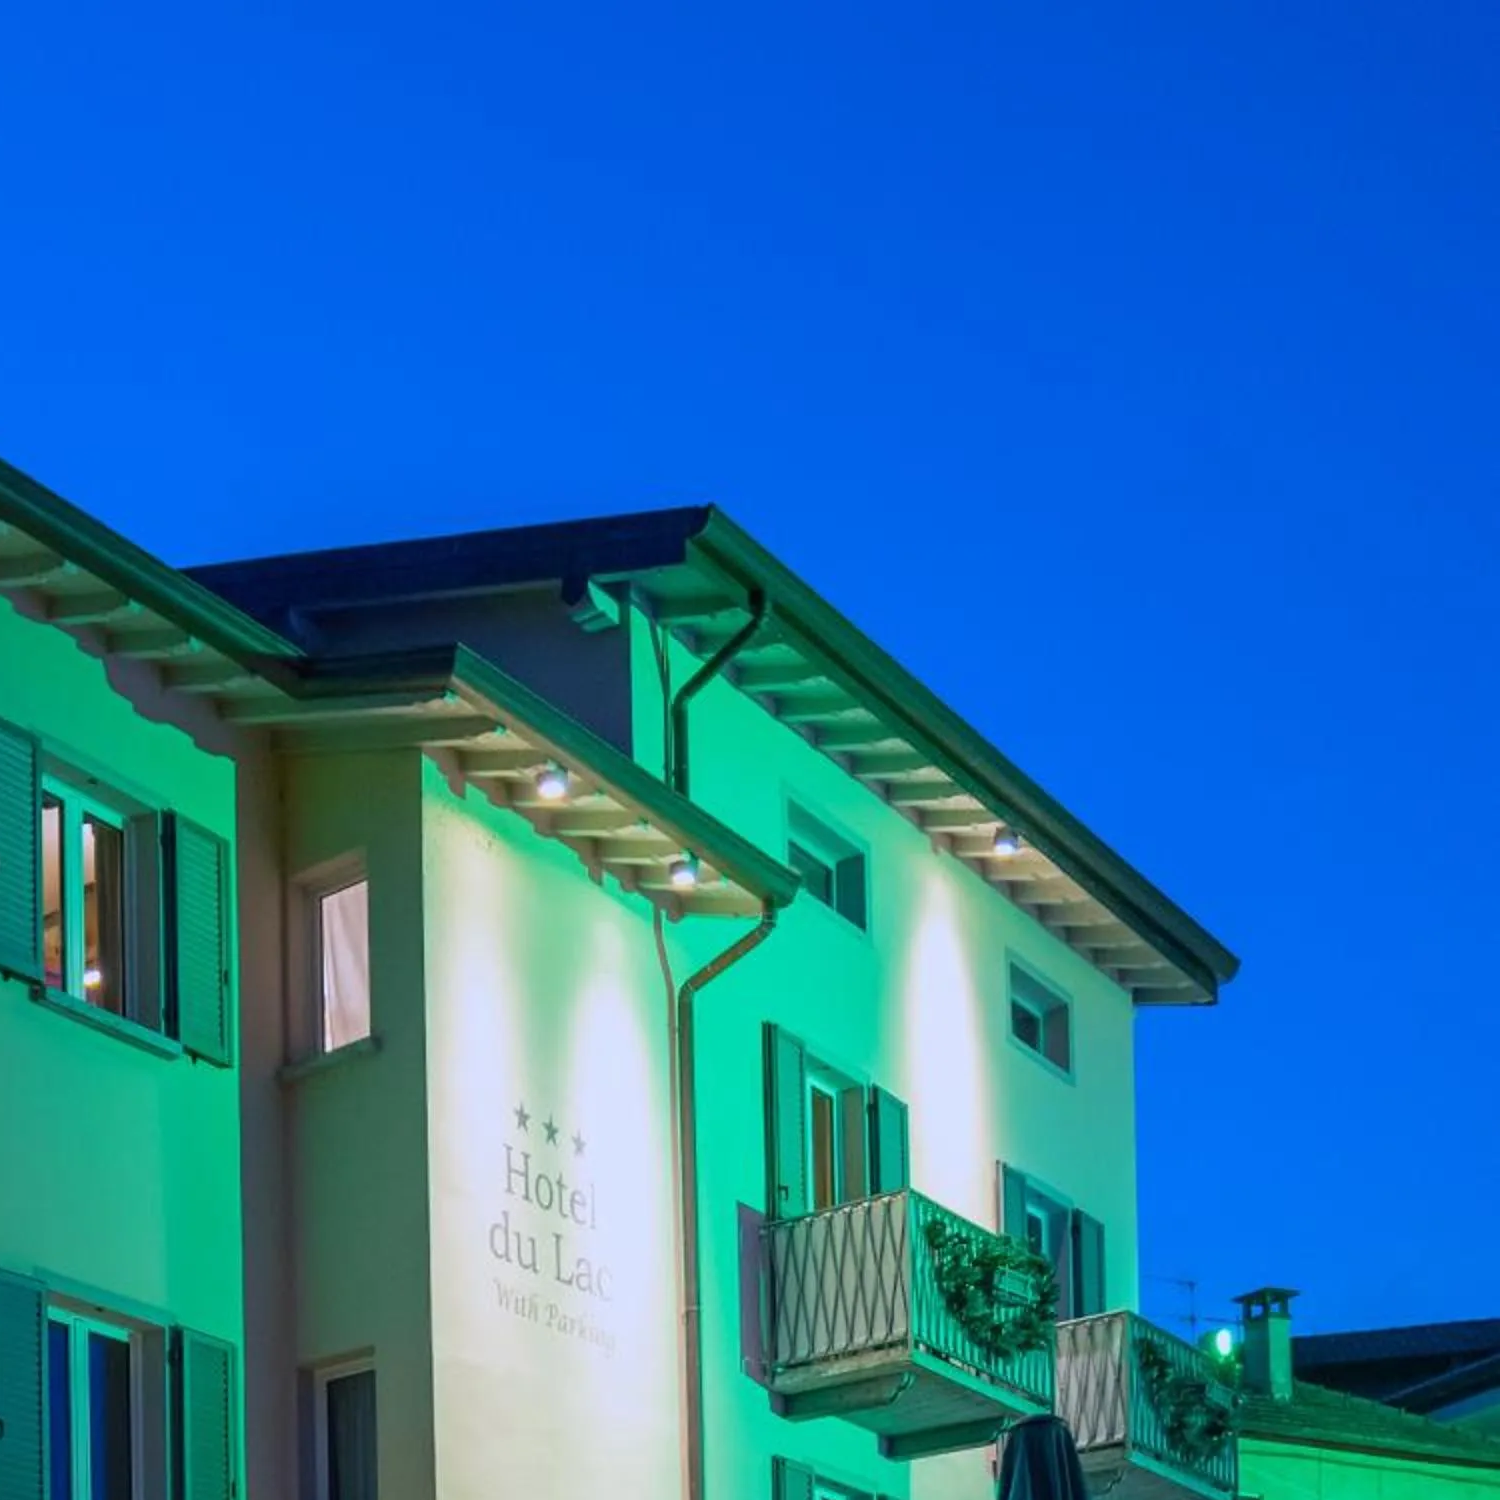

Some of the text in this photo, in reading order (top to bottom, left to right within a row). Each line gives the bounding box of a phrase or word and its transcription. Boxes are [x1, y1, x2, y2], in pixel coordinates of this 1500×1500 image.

[502, 1143, 597, 1230] Hotel
[489, 1210, 613, 1301] du Lac
